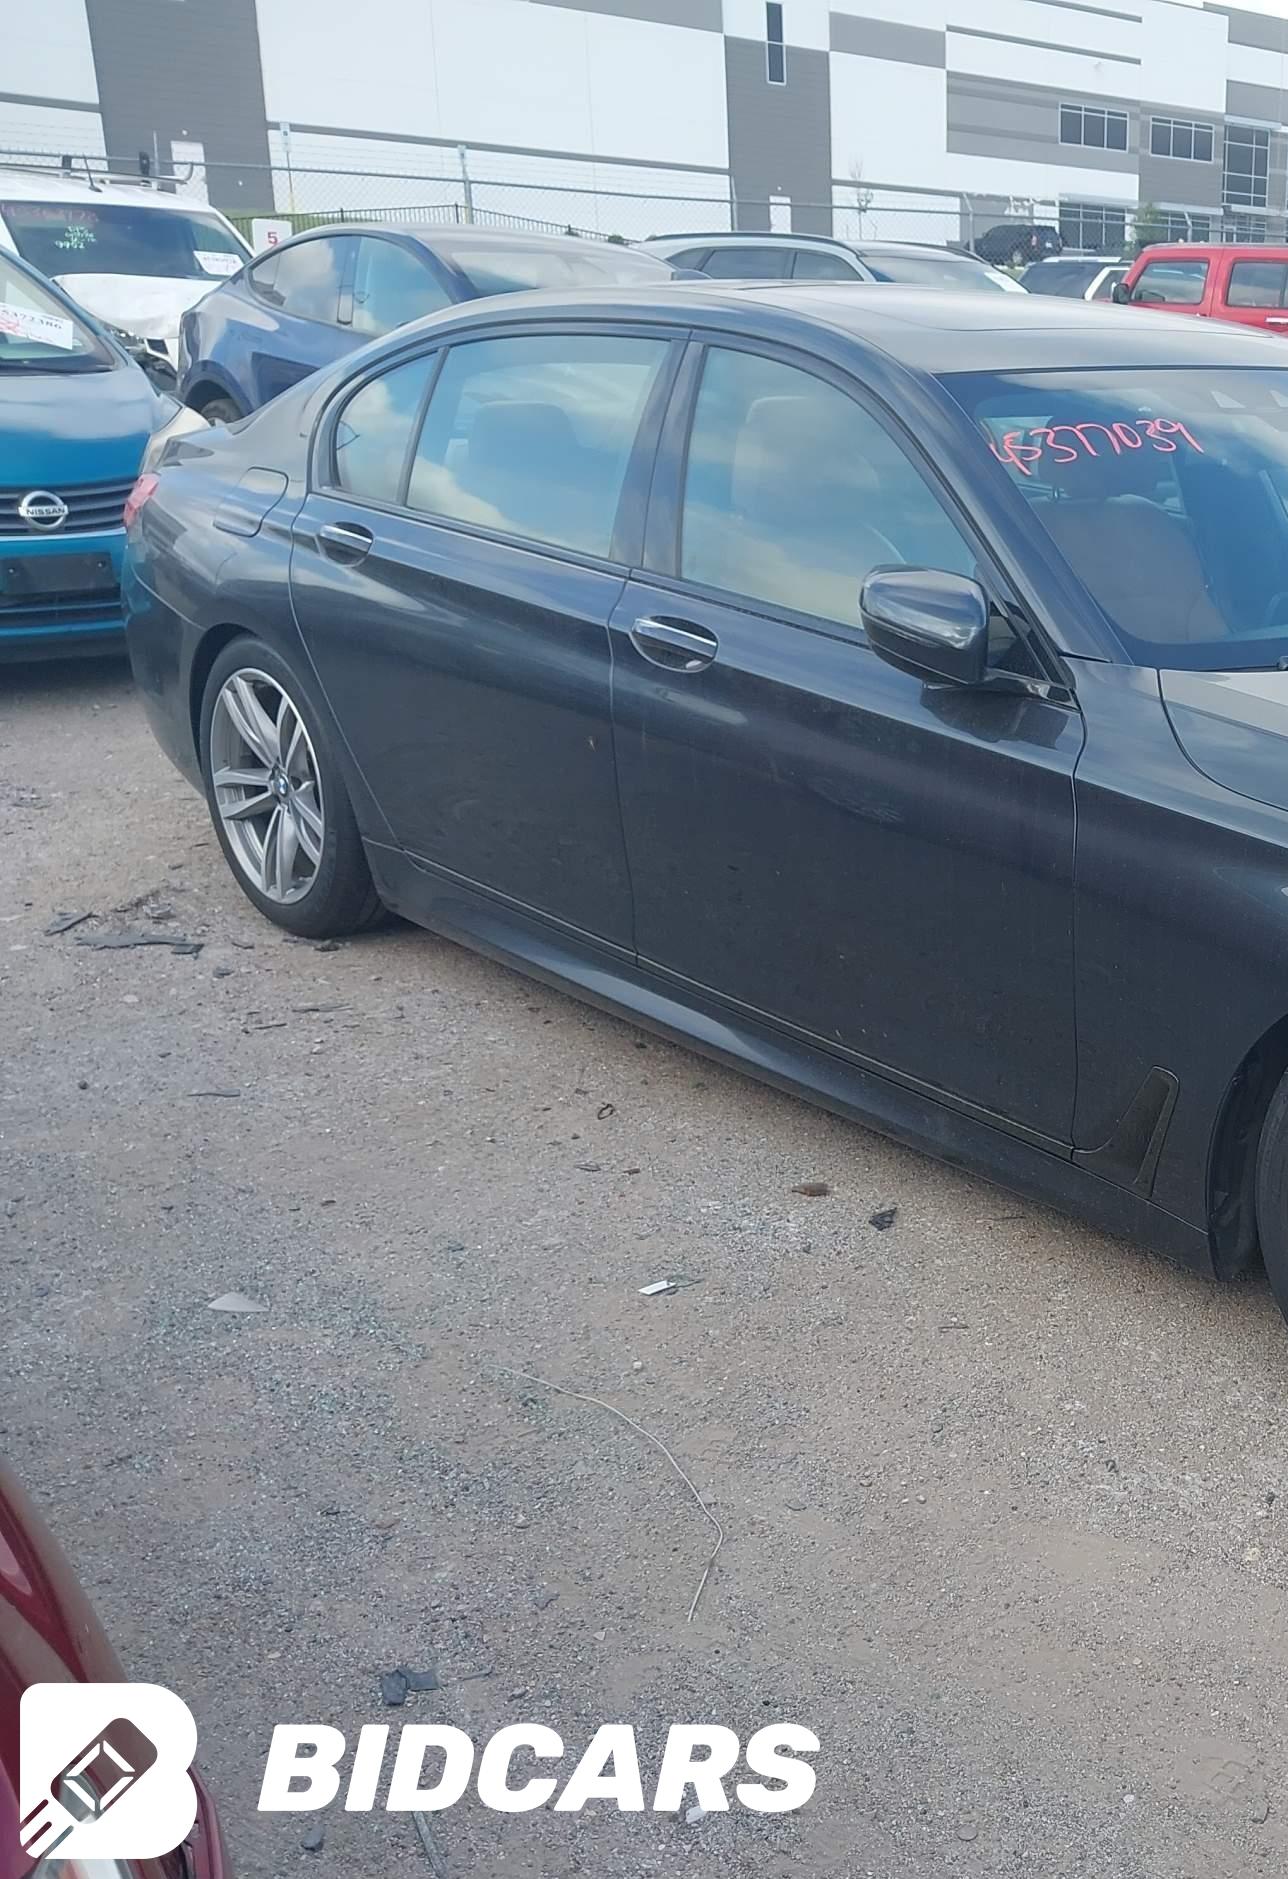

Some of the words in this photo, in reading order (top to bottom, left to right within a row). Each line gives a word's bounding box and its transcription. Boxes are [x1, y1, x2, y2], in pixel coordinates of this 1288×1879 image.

[267, 231, 278, 244] 5
[988, 417, 1205, 476] 45377039
[26, 507, 66, 516] NISSAN
